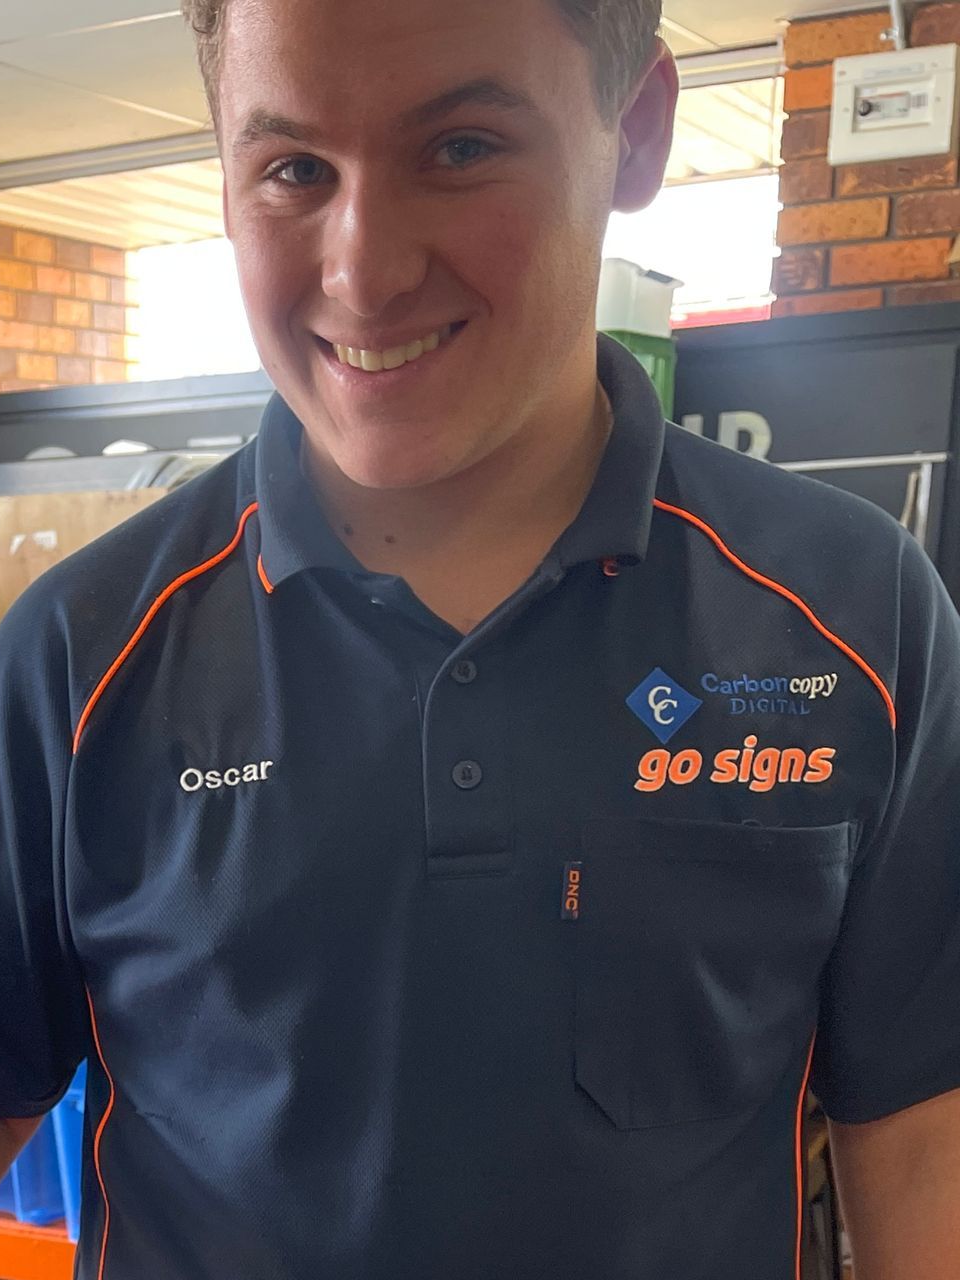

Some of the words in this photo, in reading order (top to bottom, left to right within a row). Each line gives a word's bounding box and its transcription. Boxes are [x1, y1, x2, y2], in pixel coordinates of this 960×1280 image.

[729, 697, 811, 716] DIGITAL
[179, 760, 274, 792] Oscar
[633, 748, 703, 793] go
[709, 734, 837, 793] signs
[565, 870, 580, 911] DNC
